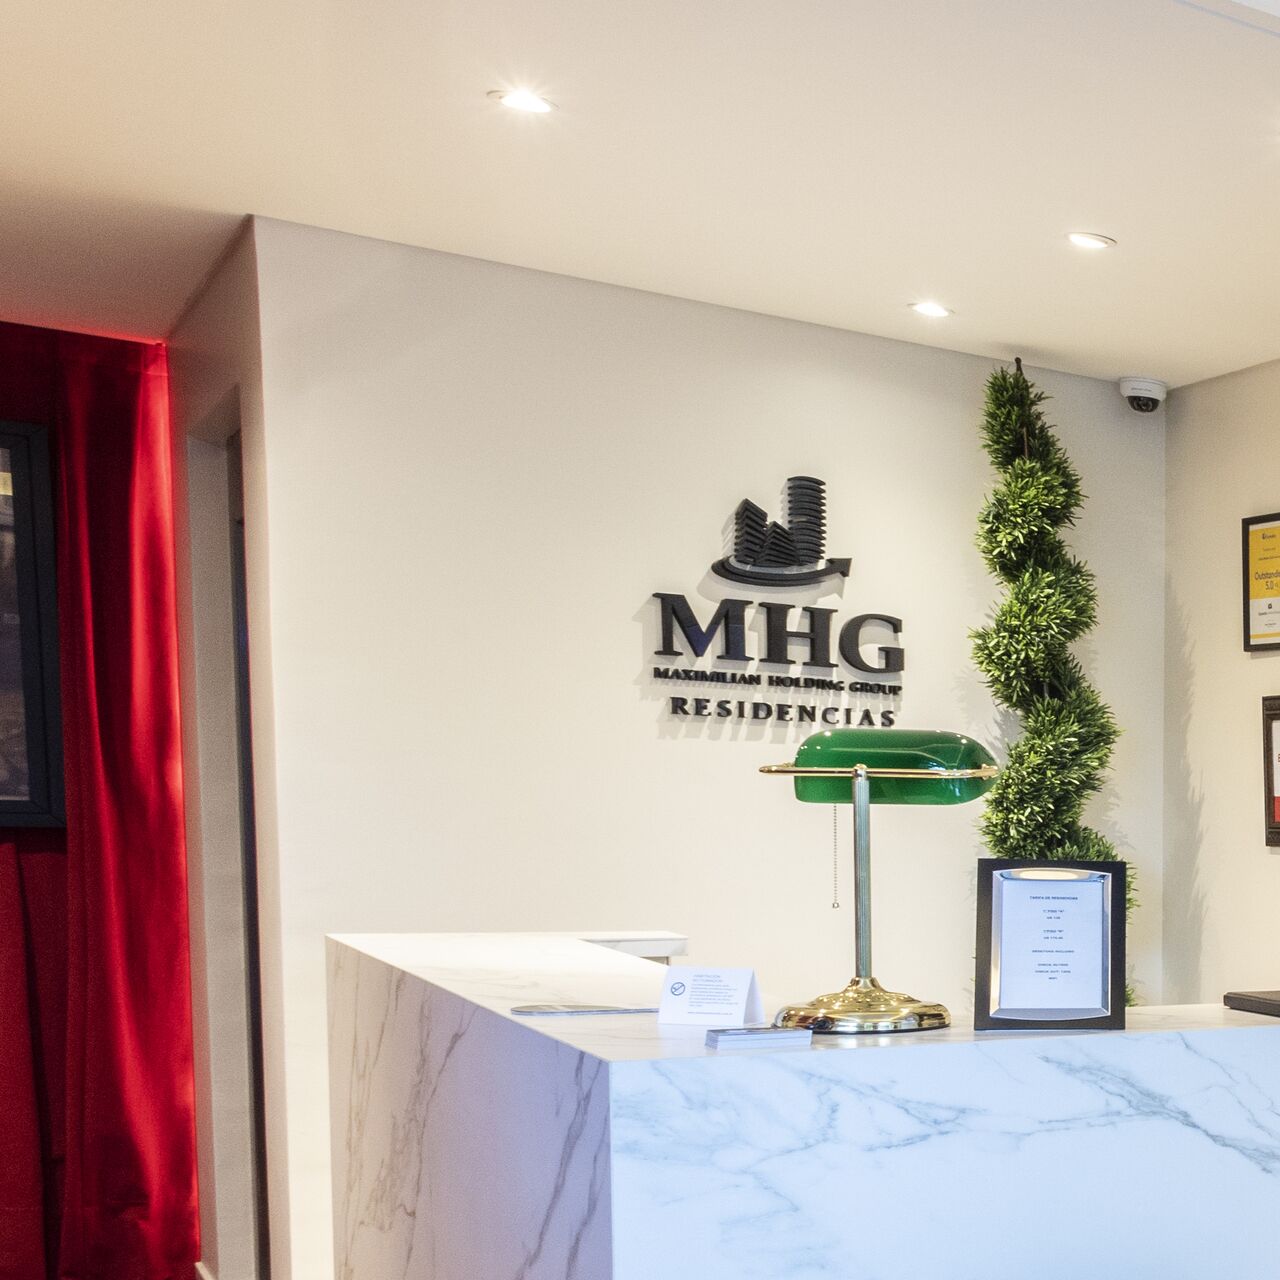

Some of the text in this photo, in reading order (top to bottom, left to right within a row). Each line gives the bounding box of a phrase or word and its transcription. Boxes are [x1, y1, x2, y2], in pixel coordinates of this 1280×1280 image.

[1265, 581, 1274, 591] 5.0
[652, 592, 905, 674] MHG
[653, 667, 903, 696] MAXIMILIAN HOLDING GROUP
[670, 696, 896, 727] RESIDENCIAS
